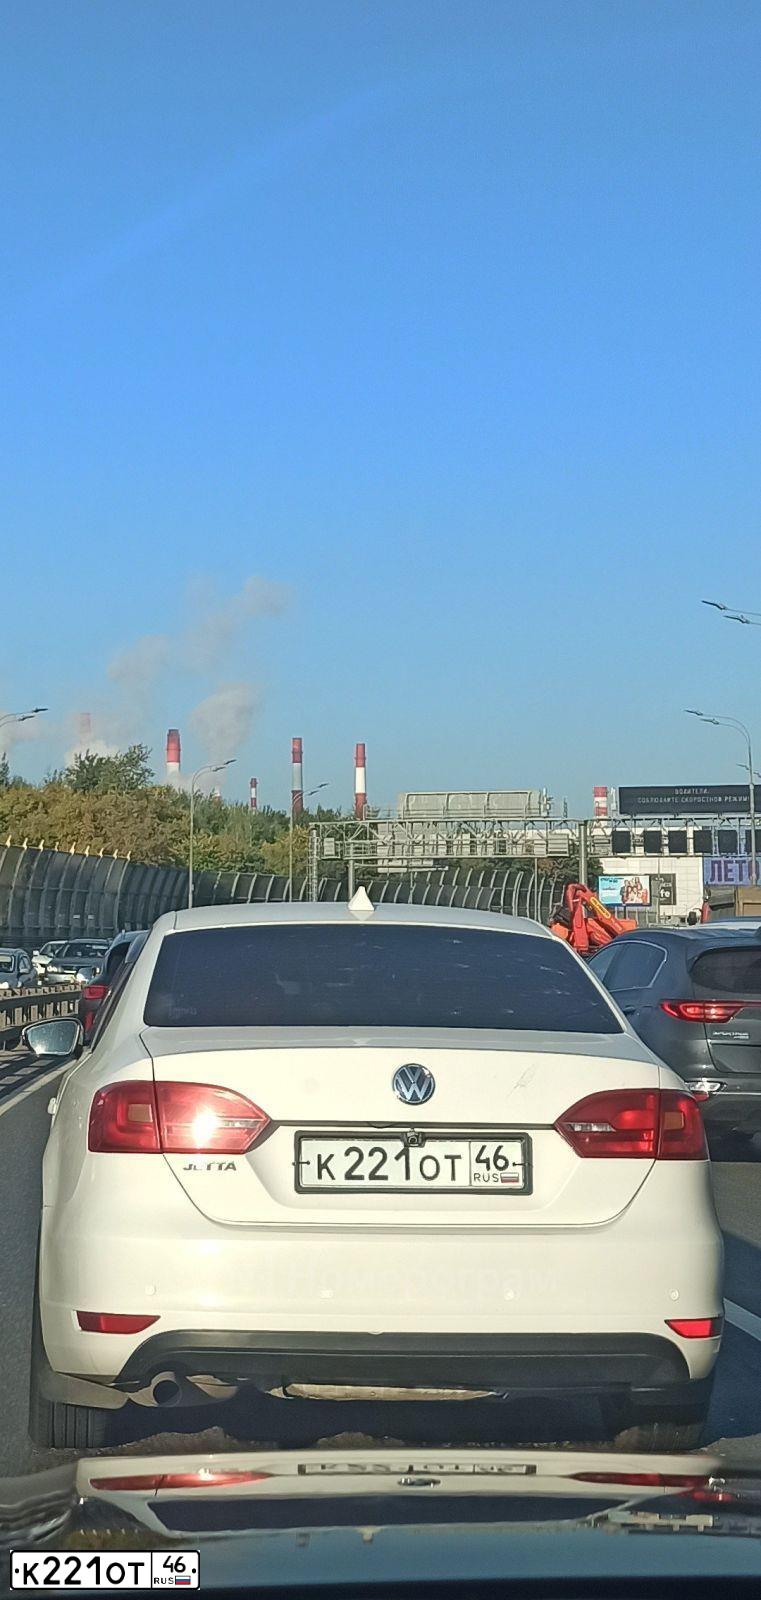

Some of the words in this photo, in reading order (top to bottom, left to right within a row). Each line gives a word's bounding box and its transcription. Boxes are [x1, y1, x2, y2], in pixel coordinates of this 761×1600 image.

[710, 859, 760, 882] ЛЕТО
[475, 1145, 510, 1172] 46
[473, 1172, 499, 1183] RUS
